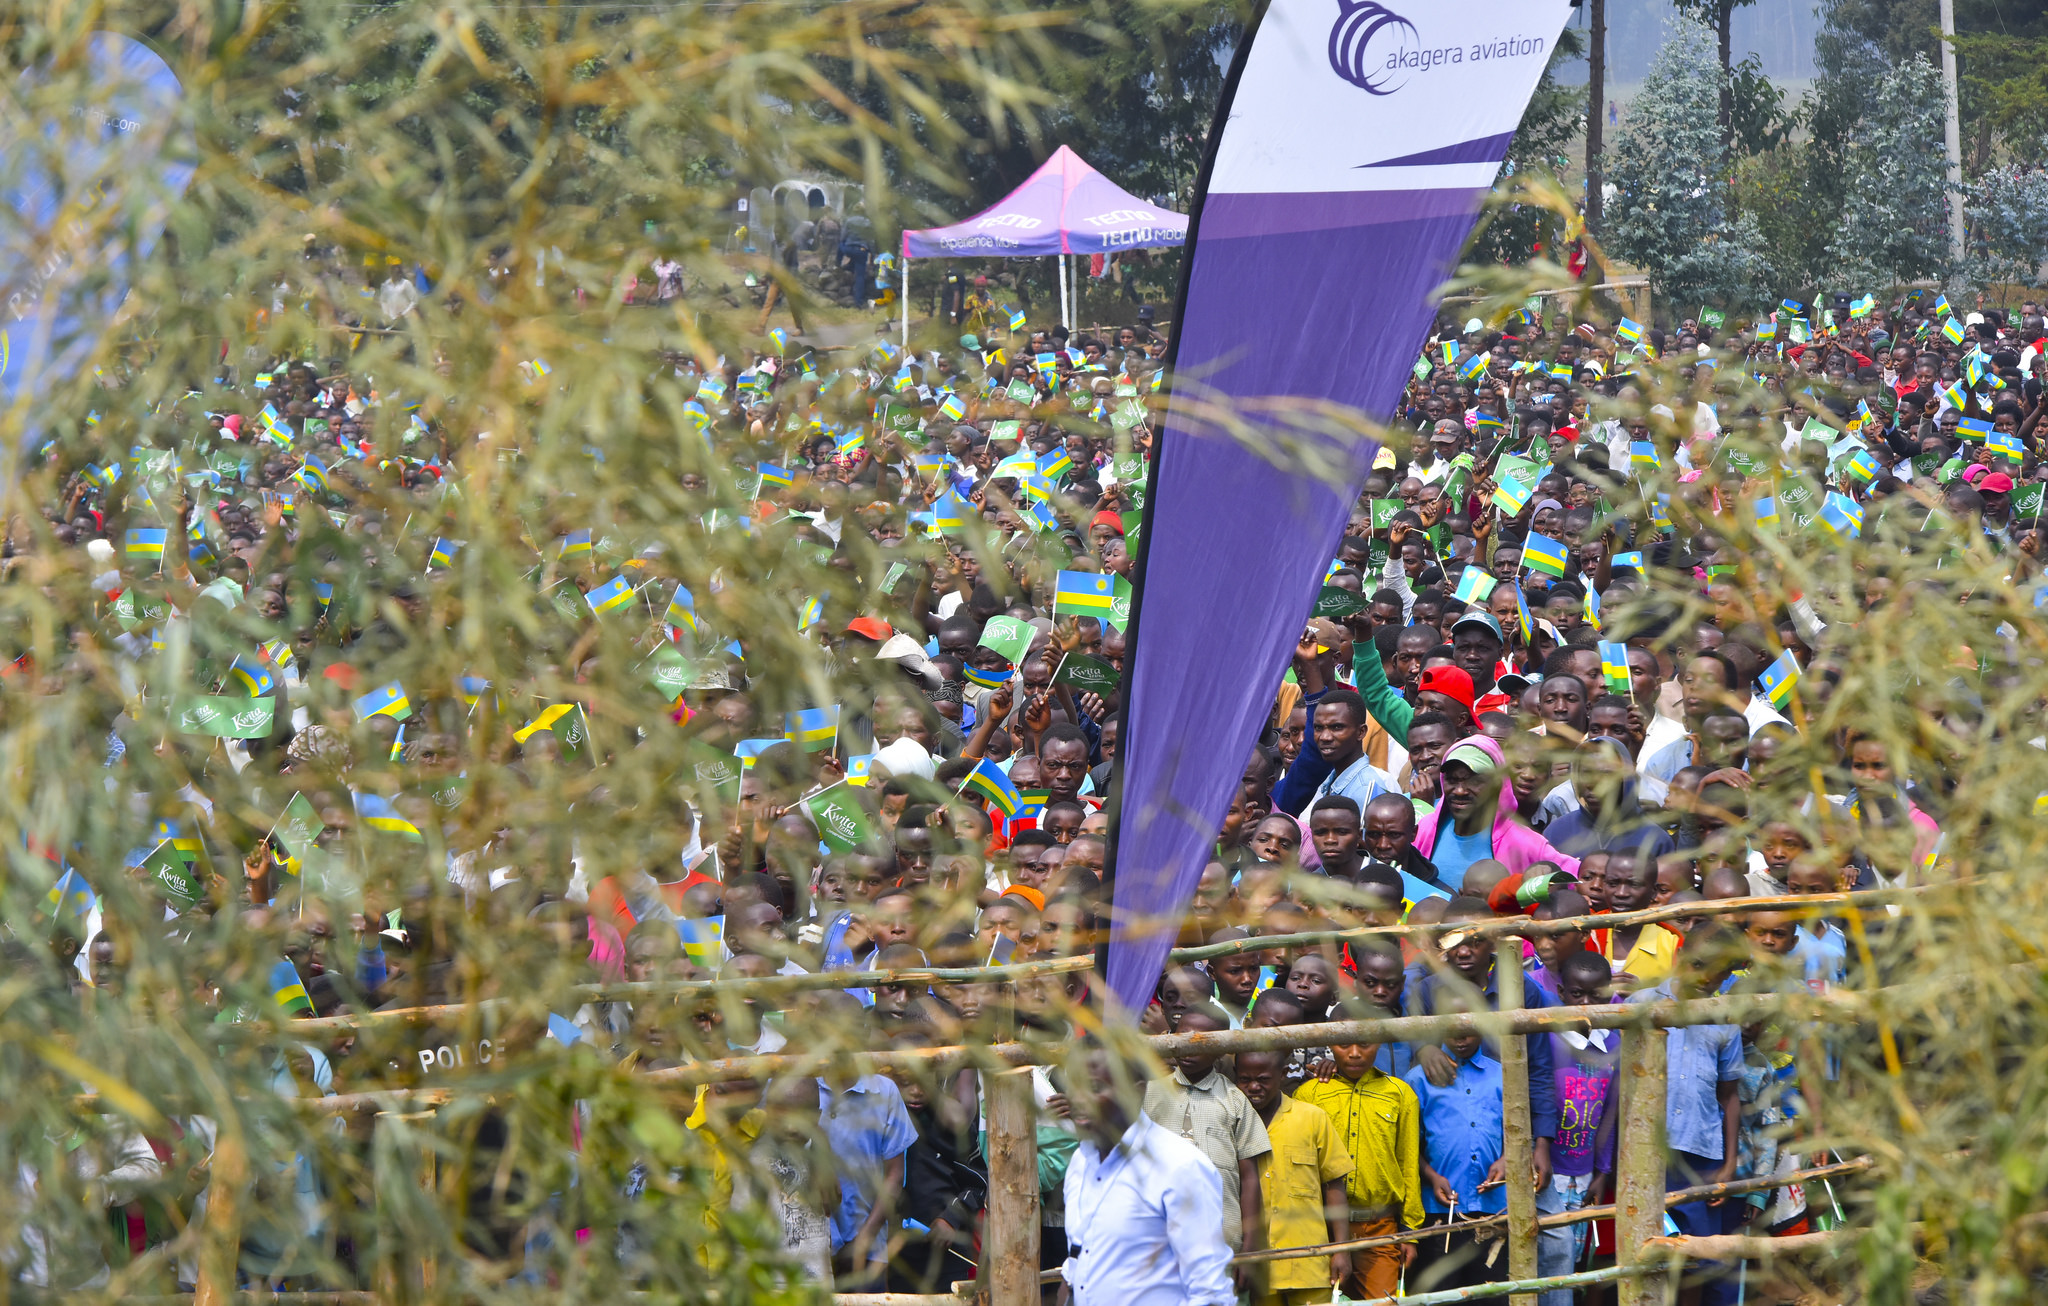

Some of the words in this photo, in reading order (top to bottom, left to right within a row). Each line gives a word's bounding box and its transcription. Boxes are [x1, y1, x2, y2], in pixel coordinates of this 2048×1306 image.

[1386, 46, 1463, 72] akagera
[1470, 34, 1544, 62] aviation
[976, 213, 1042, 229] TECNO
[1083, 209, 1156, 226] TECNO
[1098, 227, 1152, 247] TECNO
[1779, 486, 1804, 506] Kwita
[2014, 491, 2038, 514] Kwita
[1369, 548, 1386, 557] wita
[1068, 665, 1101, 680] Kwita
[231, 707, 262, 732] Kwita
[820, 802, 857, 830] Kwita
[157, 862, 187, 888] Kwita
[1565, 1075, 1609, 1101] BEST
